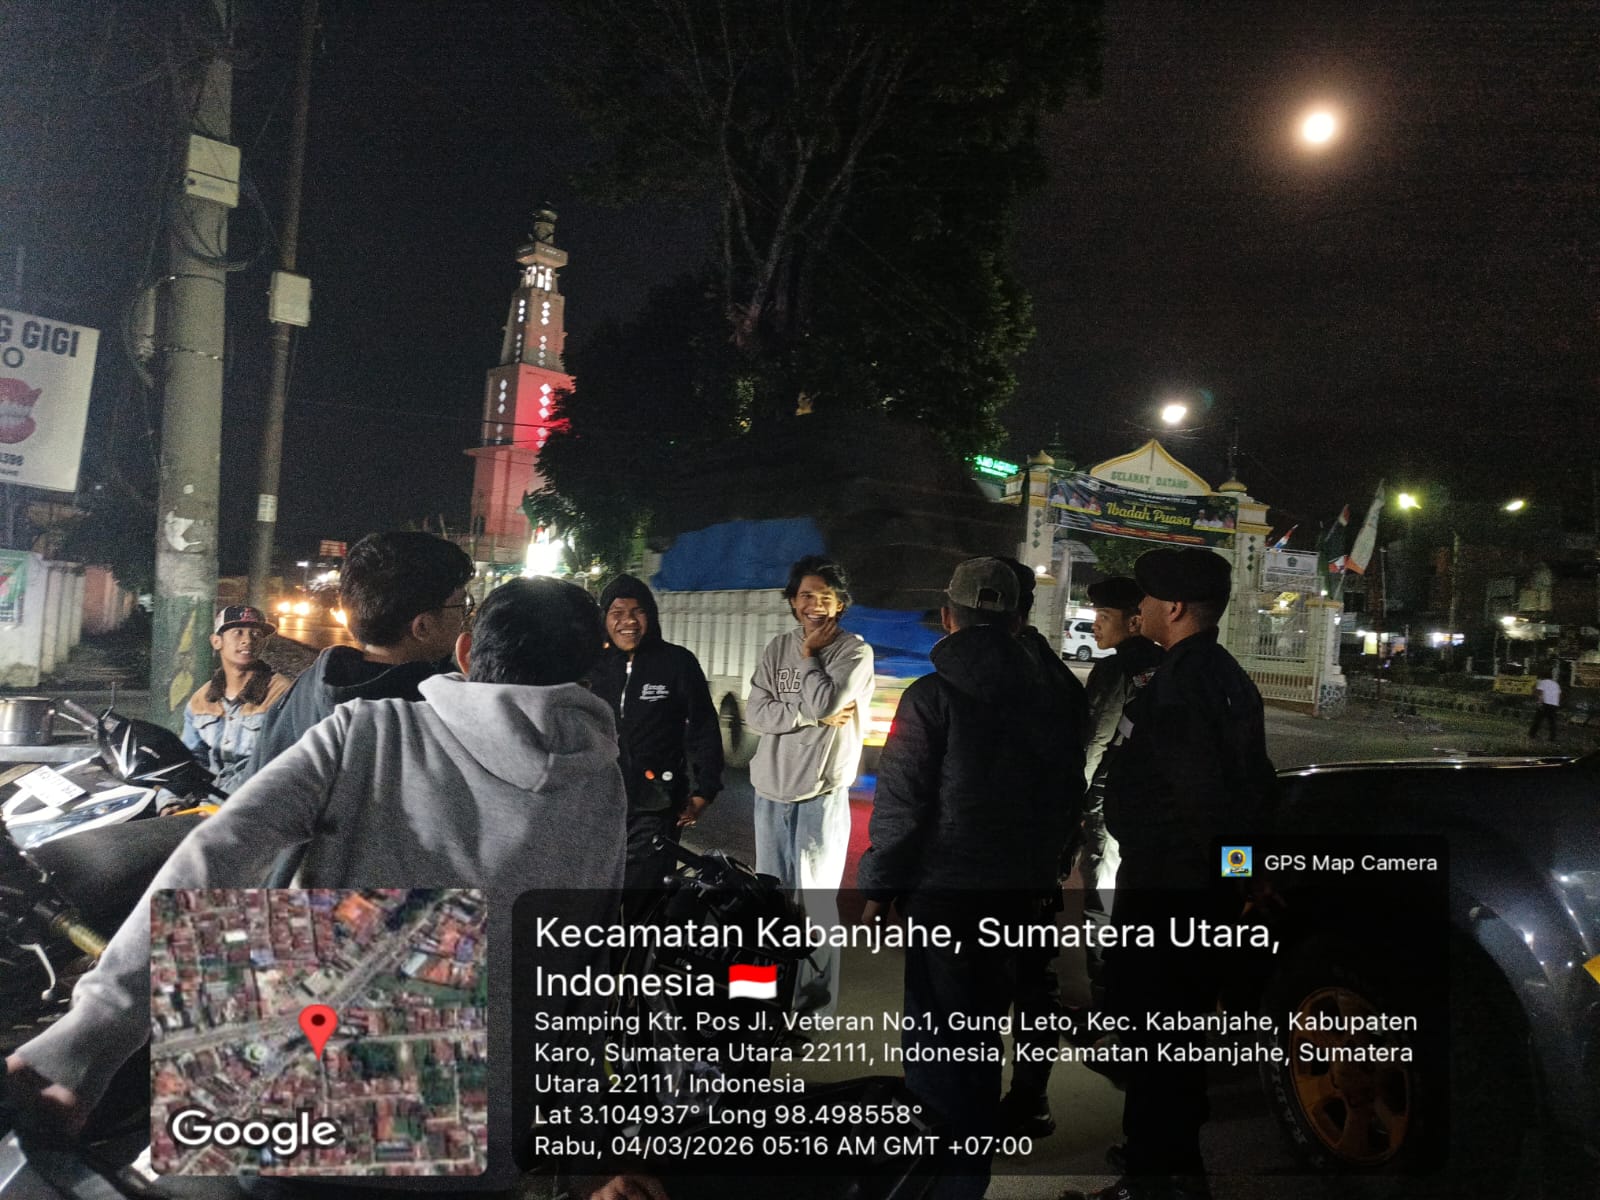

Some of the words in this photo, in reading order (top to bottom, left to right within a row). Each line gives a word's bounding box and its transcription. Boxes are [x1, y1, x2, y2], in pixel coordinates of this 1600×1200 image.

[22, 320, 80, 358] GIGI
[1110, 470, 1152, 485] SELAMAT
[1156, 476, 1190, 489] DATANG
[1106, 501, 1152, 521] Ibadah
[1152, 509, 1192, 526] Puasa
